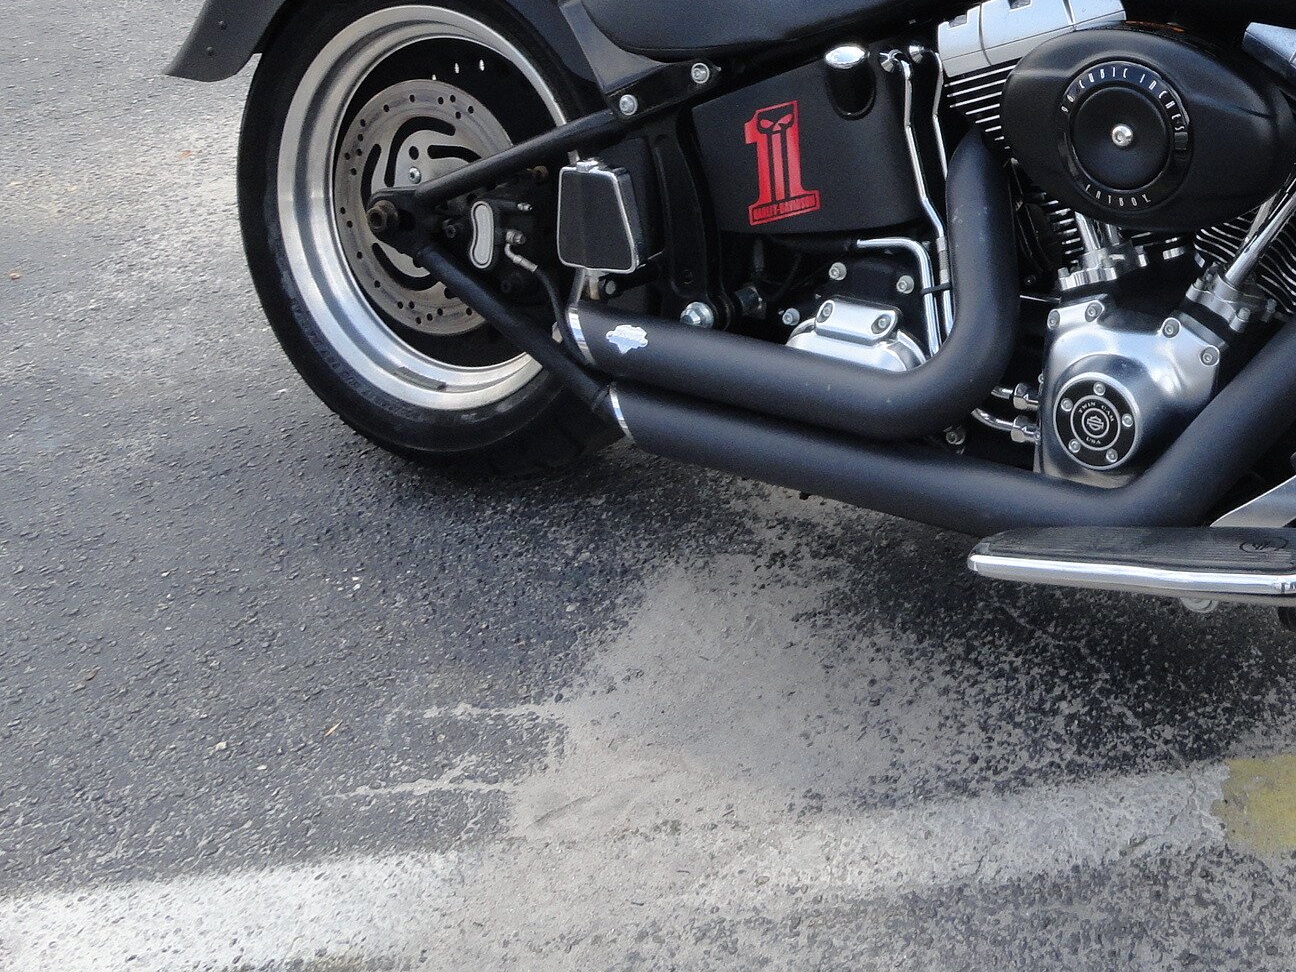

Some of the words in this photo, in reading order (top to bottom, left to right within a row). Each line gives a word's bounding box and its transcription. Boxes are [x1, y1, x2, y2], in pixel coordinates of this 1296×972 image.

[1078, 67, 1129, 89] CUBIC
[1139, 73, 1186, 132] INCHES
[1078, 401, 1096, 414] TWIN
[1100, 405, 1115, 422] CAM
